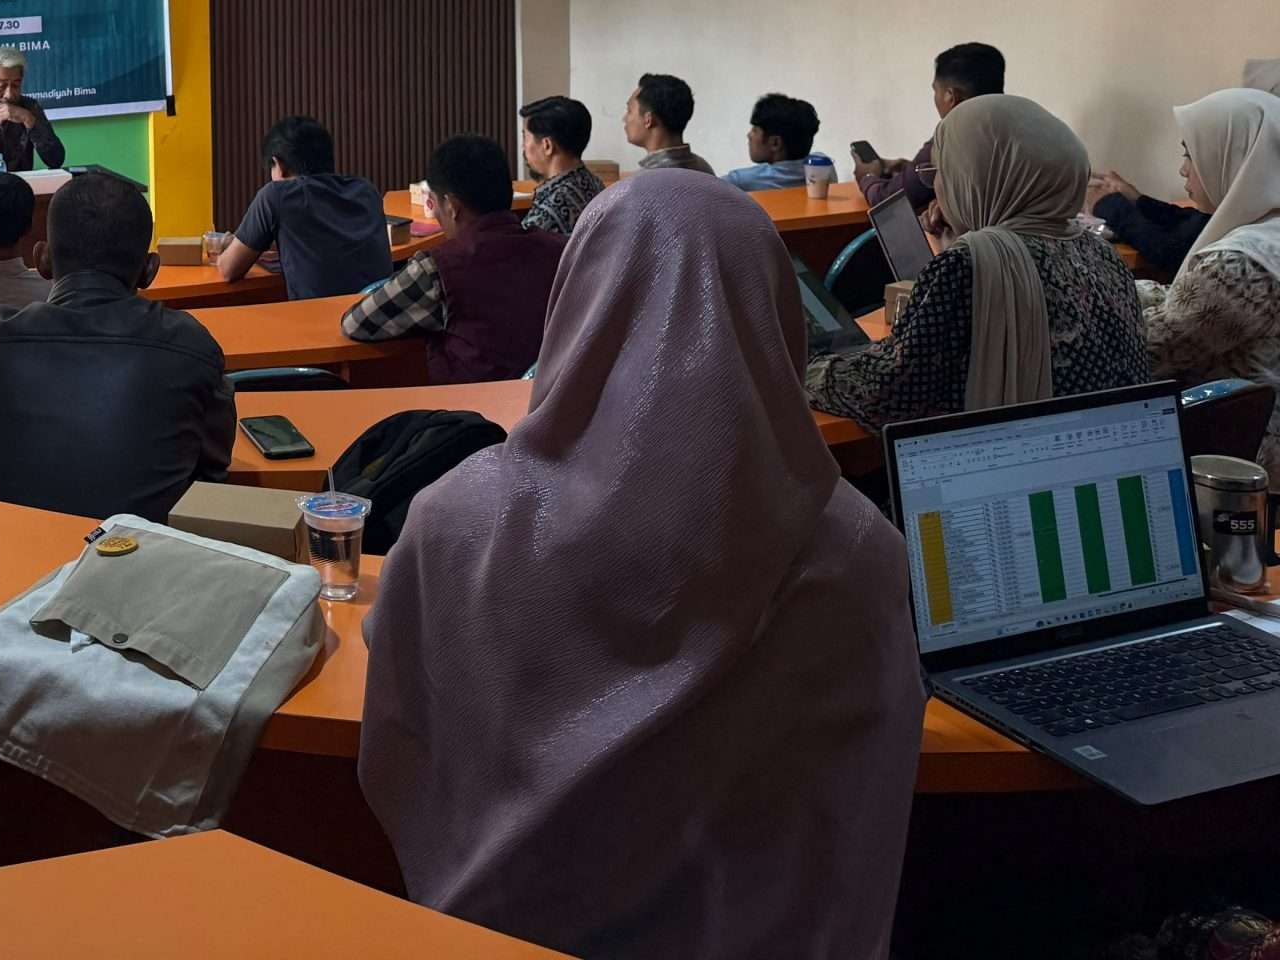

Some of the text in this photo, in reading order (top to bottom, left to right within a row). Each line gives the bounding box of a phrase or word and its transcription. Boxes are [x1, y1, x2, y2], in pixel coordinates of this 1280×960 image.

[19, 40, 51, 52] BIMA
[74, 86, 97, 97] Bima
[1230, 519, 1255, 530] 555
